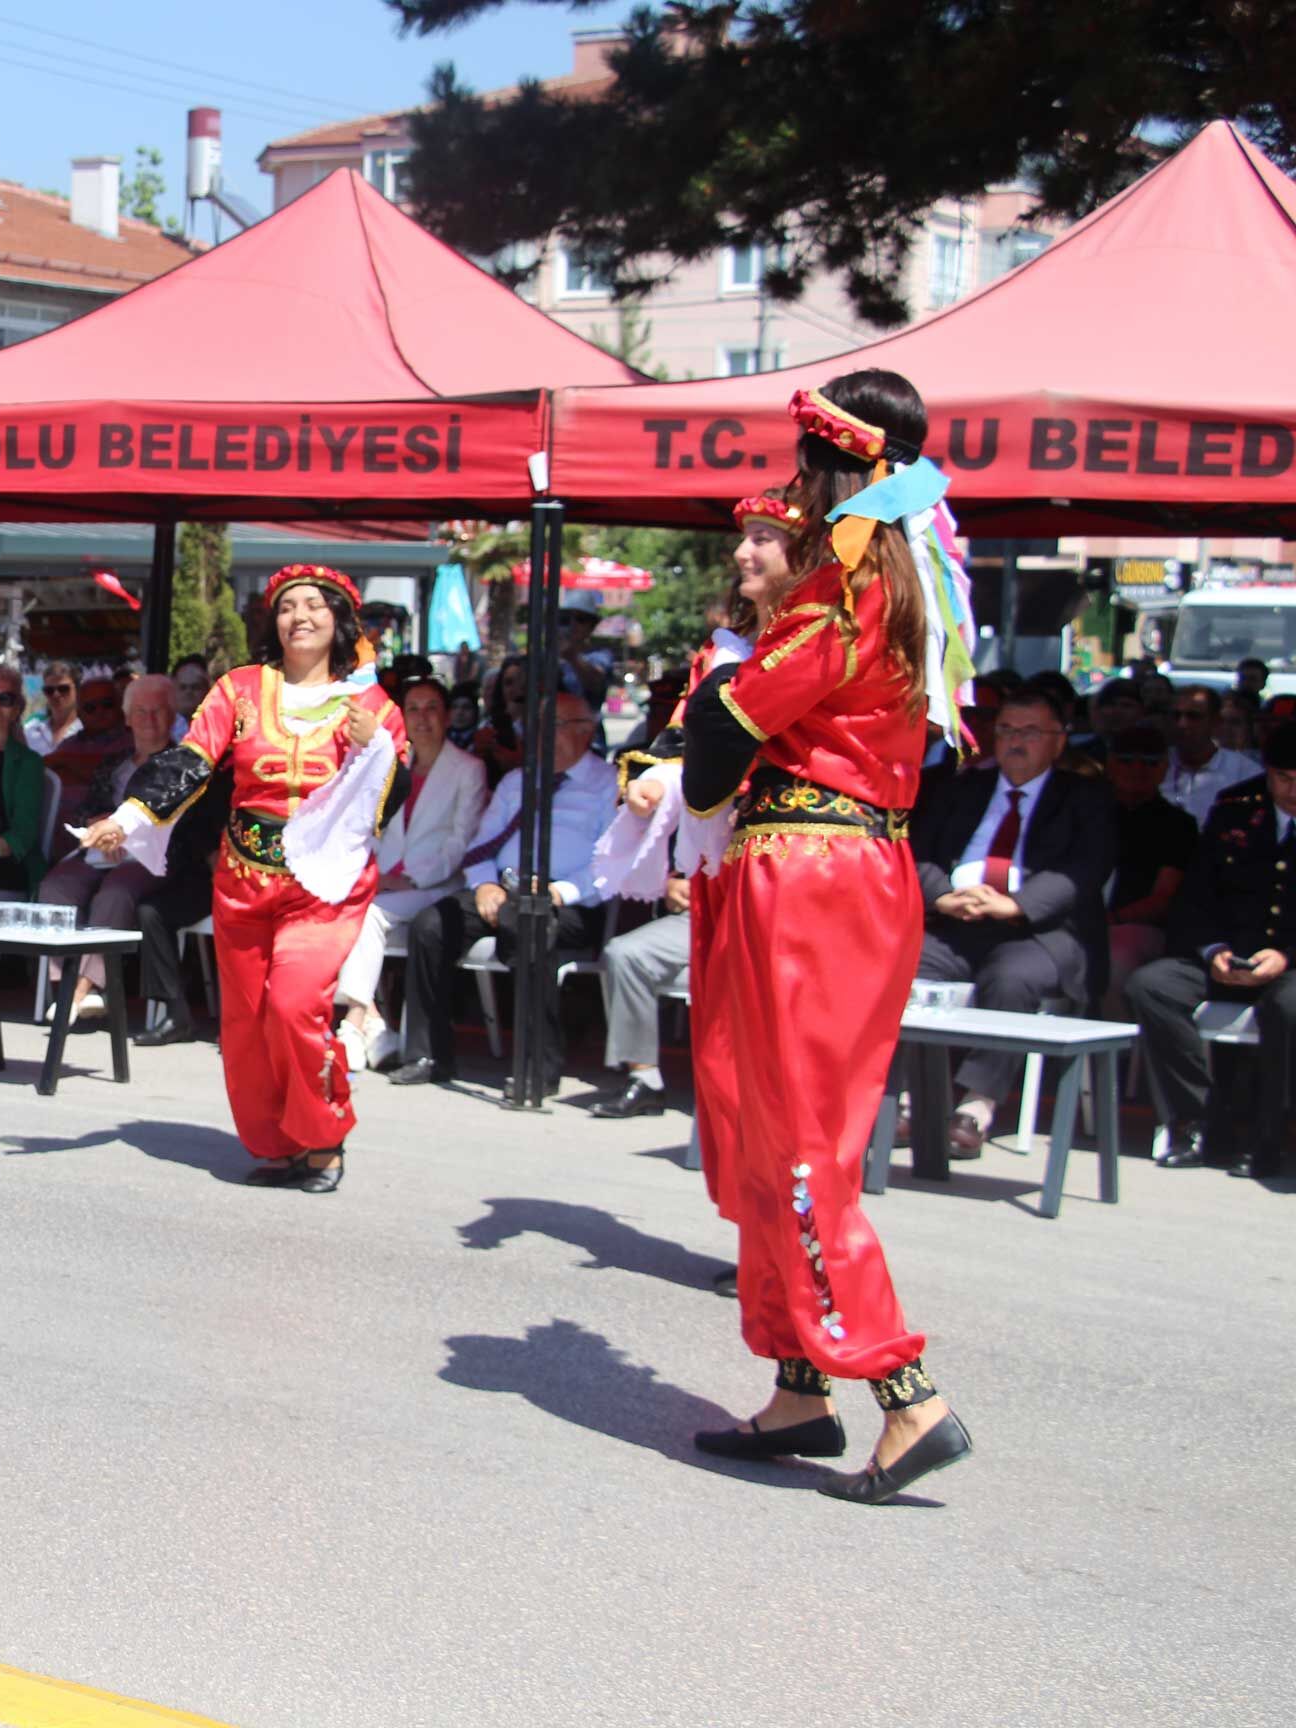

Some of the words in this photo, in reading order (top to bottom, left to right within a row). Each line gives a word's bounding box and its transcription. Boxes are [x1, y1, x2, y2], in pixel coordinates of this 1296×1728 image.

[98, 413, 462, 474] BELEDİYESİ
[643, 418, 768, 470] T.C.
[1028, 417, 1296, 478] BELED
